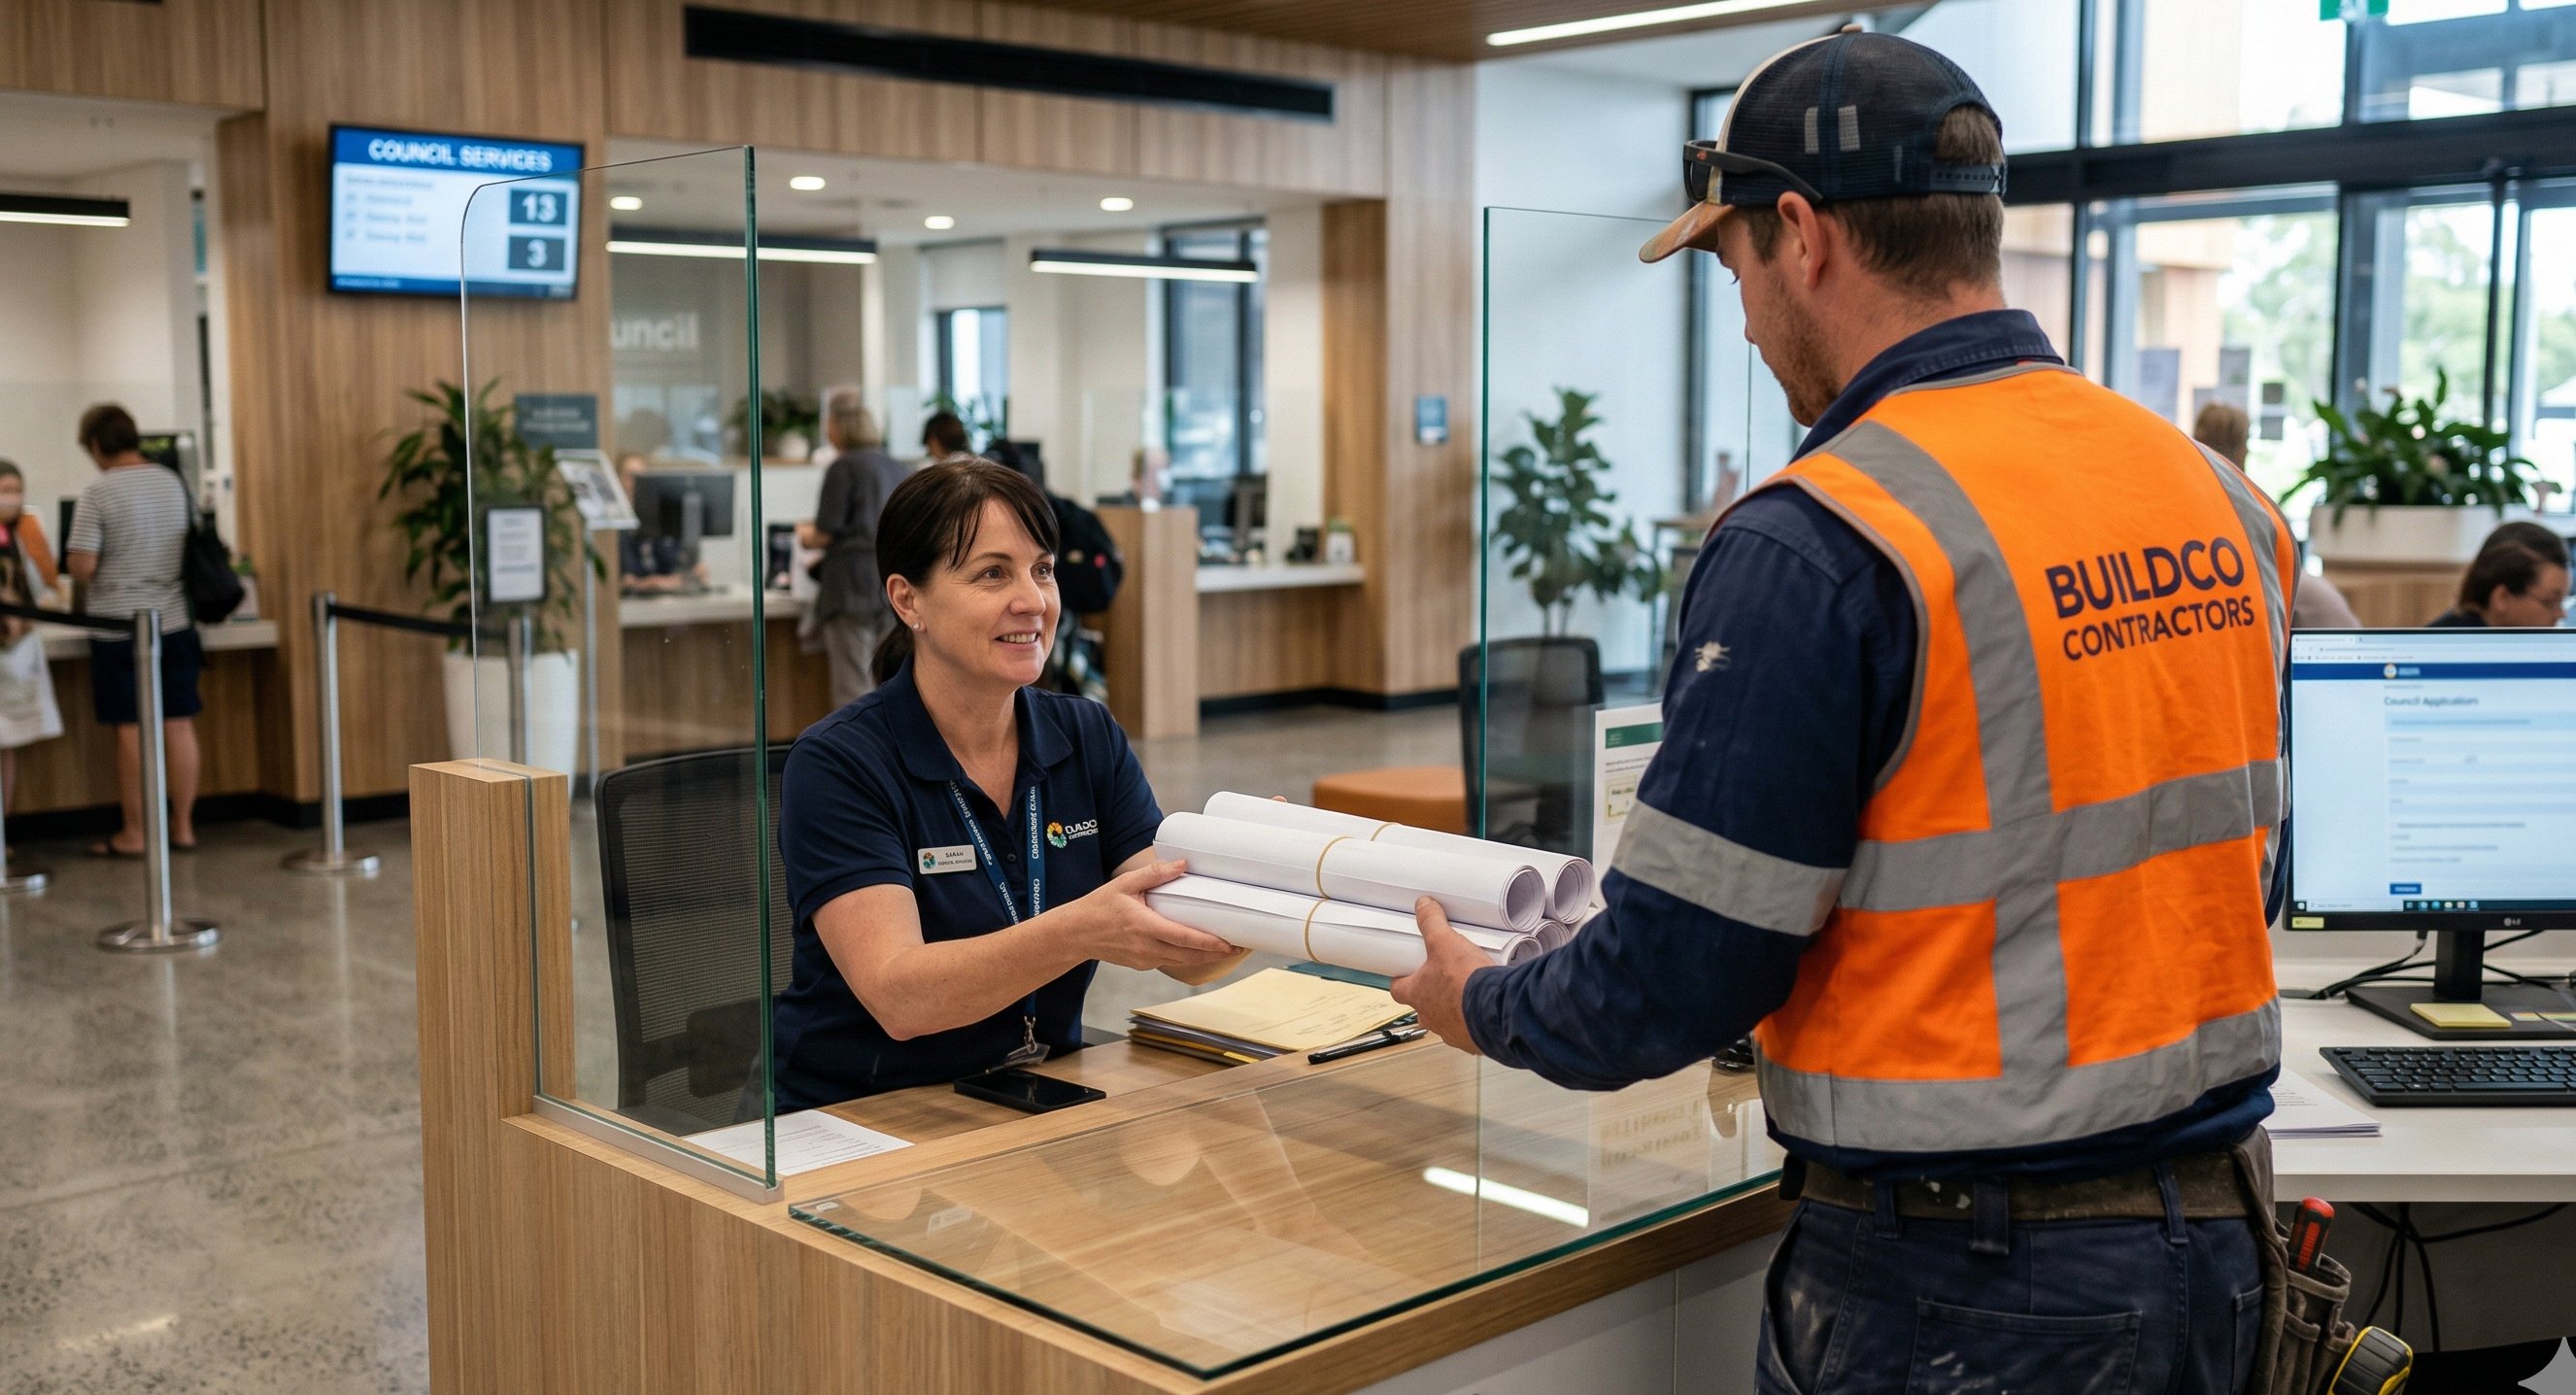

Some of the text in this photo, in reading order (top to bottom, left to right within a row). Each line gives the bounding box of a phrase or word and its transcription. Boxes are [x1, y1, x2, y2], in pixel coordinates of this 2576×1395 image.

[368, 138, 553, 173] COUNCIL SERVICES
[523, 193, 558, 222] 13
[527, 239, 547, 268] 3
[2046, 536, 2245, 619] BUILDCO
[2063, 595, 2254, 661] CONTRACTORS
